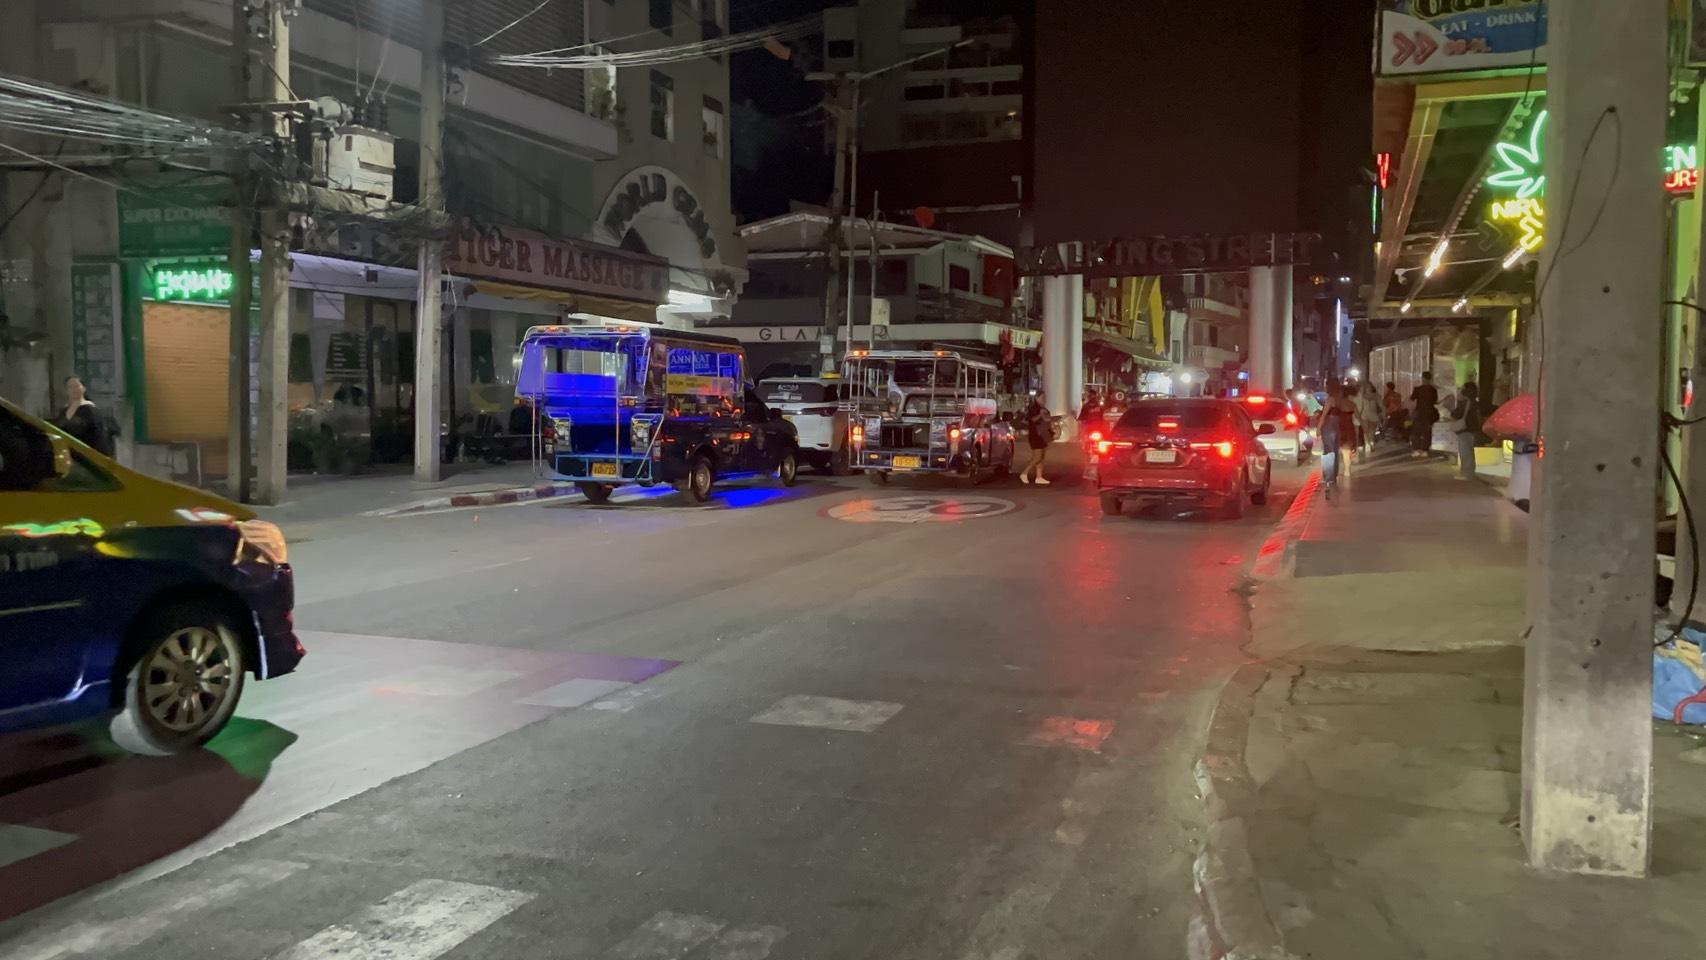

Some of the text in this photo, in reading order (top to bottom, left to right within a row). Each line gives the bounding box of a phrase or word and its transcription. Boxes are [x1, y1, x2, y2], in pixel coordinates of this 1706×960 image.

[1441, 20, 1468, 35] EAT
[1486, 12, 1536, 27] DRINK
[1664, 145, 1697, 171] EN
[1491, 199, 1543, 219] NIRV
[445, 229, 533, 273] TIGER
[542, 245, 643, 290] MASSAGE
